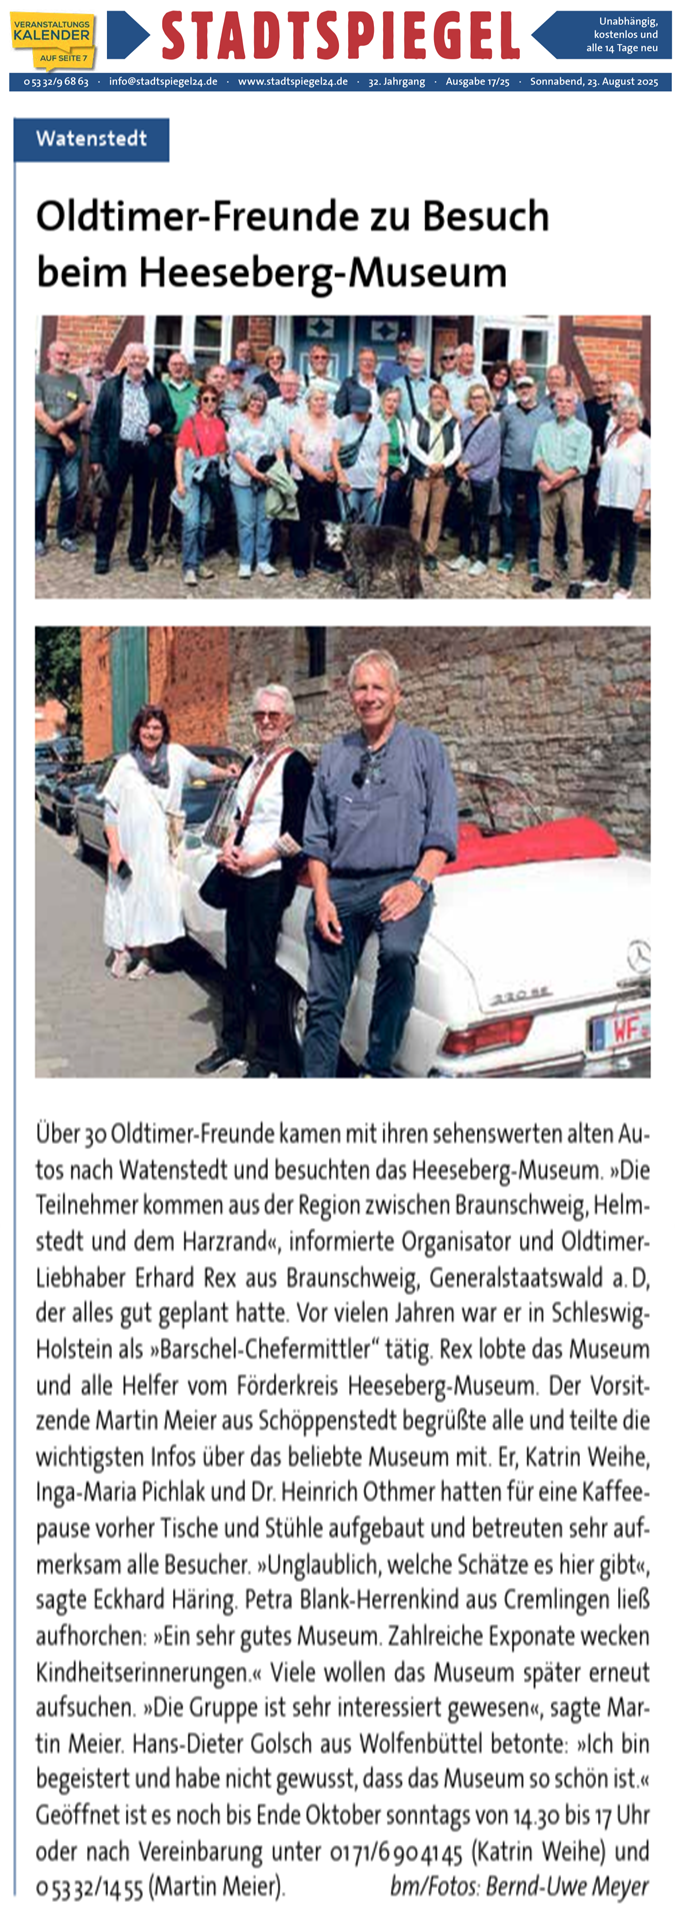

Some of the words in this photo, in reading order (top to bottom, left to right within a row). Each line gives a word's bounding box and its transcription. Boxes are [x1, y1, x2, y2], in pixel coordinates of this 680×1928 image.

[13, 30, 90, 40] KALENDER
[162, 10, 521, 60] STADTSPIEGEL
[594, 30, 638, 38] kostenlos
[640, 30, 658, 38] und
[599, 17, 658, 28] Unabhängig,
[586, 43, 602, 52] alle
[616, 44, 638, 54] Tage
[109, 76, 218, 88] info@stadtspiegel24.de
[238, 76, 348, 88] www.stadtspiegel24.de
[368, 78, 381, 87] 32.
[383, 76, 426, 88] Jahrgang
[446, 76, 485, 88] Ausgabe
[487, 77, 510, 87] 17/25
[530, 76, 586, 87] Sonnabend,
[587, 78, 600, 87] 23.
[601, 76, 636, 88] August
[637, 78, 659, 86] 2025
[35, 129, 147, 146] Watenstedt
[36, 198, 359, 231] Oldtimer-Freunde
[370, 207, 409, 231] zu
[423, 198, 549, 231] Besuch
[38, 254, 126, 287] beim
[140, 254, 506, 298] Heeseberg-Museum
[36, 1119, 81, 1144] Über
[84, 1127, 107, 1149] 30
[110, 1121, 275, 1144] Oldtimer-Freunde
[279, 1121, 341, 1144] kamen
[345, 1122, 377, 1144] mit
[382, 1121, 428, 1144] ihren
[432, 1121, 562, 1144] sehenswerten
[567, 1121, 613, 1144] alten
[617, 1123, 650, 1144] Au-
[34, 1159, 64, 1180] tos
[70, 1158, 113, 1180] nach
[118, 1158, 227, 1180] Watenstedt
[233, 1158, 268, 1180] und
[274, 1158, 369, 1180] besuchten
[375, 1158, 407, 1180] das
[412, 1158, 603, 1187] Heeseberg-Museum.
[610, 1159, 650, 1180] »Die
[35, 1192, 139, 1215] Teilnehmer
[143, 1192, 223, 1215] kommen
[228, 1199, 260, 1215] aus
[263, 1192, 294, 1215] der
[298, 1193, 360, 1222] Region
[365, 1193, 450, 1215] zwischen
[455, 1192, 589, 1222] Braunschweig,
[594, 1192, 650, 1215] Helm-
[35, 1229, 83, 1251] stedt
[91, 1229, 126, 1251] und
[133, 1229, 174, 1251] dem
[183, 1229, 281, 1255] Harzrand«,
[289, 1228, 394, 1251] informierte
[401, 1230, 511, 1258] Organisator
[519, 1229, 553, 1251] und
[561, 1229, 650, 1251] Oldtimer-
[35, 1300, 66, 1323] der
[71, 1300, 113, 1323] alles
[120, 1302, 152, 1330] gut
[158, 1300, 228, 1330] geplant
[235, 1300, 289, 1323] hatte.
[296, 1302, 328, 1323] Vor
[333, 1300, 388, 1323] vielen
[394, 1300, 454, 1323] Jahren
[461, 1306, 497, 1323] war
[503, 1307, 522, 1323] er
[528, 1301, 544, 1322] in
[551, 1300, 650, 1330] Schleswig-
[36, 1373, 70, 1396] und
[80, 1373, 112, 1396] alle
[122, 1373, 179, 1396] Helfer
[187, 1380, 227, 1396] vom
[237, 1373, 338, 1396] Förderkreis
[348, 1373, 539, 1403] Heeseberg-Museum.
[549, 1374, 581, 1396] Der
[589, 1375, 650, 1396] Vorsit-
[35, 1445, 144, 1474] wichtigsten
[151, 1444, 196, 1467] Infos
[202, 1445, 245, 1467] über
[249, 1444, 281, 1467] das
[288, 1444, 362, 1467] beliebte
[368, 1446, 449, 1467] Museum
[456, 1446, 491, 1467] mit.
[498, 1445, 519, 1470] Er,
[525, 1446, 580, 1467] Katrin
[587, 1445, 650, 1470] Weihe,
[36, 1481, 136, 1509] Inga-Maria
[142, 1479, 205, 1502] Pichlak
[210, 1479, 245, 1502] und
[251, 1480, 276, 1502] Dr.
[281, 1479, 357, 1502] Heinrich
[362, 1479, 436, 1502] Othmer
[440, 1479, 501, 1502] hatten
[506, 1479, 534, 1502] für
[538, 1481, 577, 1502] eine
[582, 1479, 650, 1502] Kaffee-
[36, 1552, 121, 1575] merksam
[126, 1552, 159, 1575] alle
[164, 1552, 251, 1575] Besucher.
[257, 1552, 382, 1582] »Unglaublich,
[386, 1552, 452, 1575] welche
[457, 1552, 528, 1575] Schätze
[533, 1559, 553, 1575] es
[559, 1552, 594, 1575] hier
[599, 1552, 650, 1582] gibt«,
[35, 1589, 87, 1616] sagte
[93, 1587, 164, 1610] Eckhard
[172, 1588, 238, 1616] Häring.
[245, 1588, 292, 1609] Petra
[300, 1587, 459, 1610] Blank-Herrenkind
[465, 1593, 497, 1609] aus
[503, 1587, 609, 1616] Cremlingen
[617, 1586, 650, 1609] ließ
[35, 1694, 136, 1717] aufsuchen.
[143, 1696, 183, 1717] »Die
[188, 1696, 258, 1724] Gruppe
[264, 1696, 286, 1717] ist
[292, 1695, 331, 1717] sehr
[337, 1696, 441, 1717] interessiert
[447, 1701, 544, 1724] gewesen«,
[550, 1696, 601, 1724] sagte
[606, 1696, 650, 1717] Mar-
[36, 1766, 130, 1795] begeistert
[135, 1766, 170, 1789] und
[175, 1766, 220, 1789] habe
[225, 1766, 271, 1789] nicht
[275, 1768, 358, 1795] gewusst,
[362, 1766, 403, 1789] dass
[407, 1766, 439, 1789] das
[443, 1767, 524, 1789] Museum
[529, 1772, 550, 1789] so
[554, 1766, 608, 1789] schön
[613, 1767, 649, 1789] ist.«
[148, 1873, 216, 1901] (Martin
[222, 1873, 285, 1902] Meier).
[390, 1874, 480, 1896] bm/Fotos:
[485, 1874, 587, 1896] Bernd-Uwe
[591, 1875, 649, 1903] Meyer
